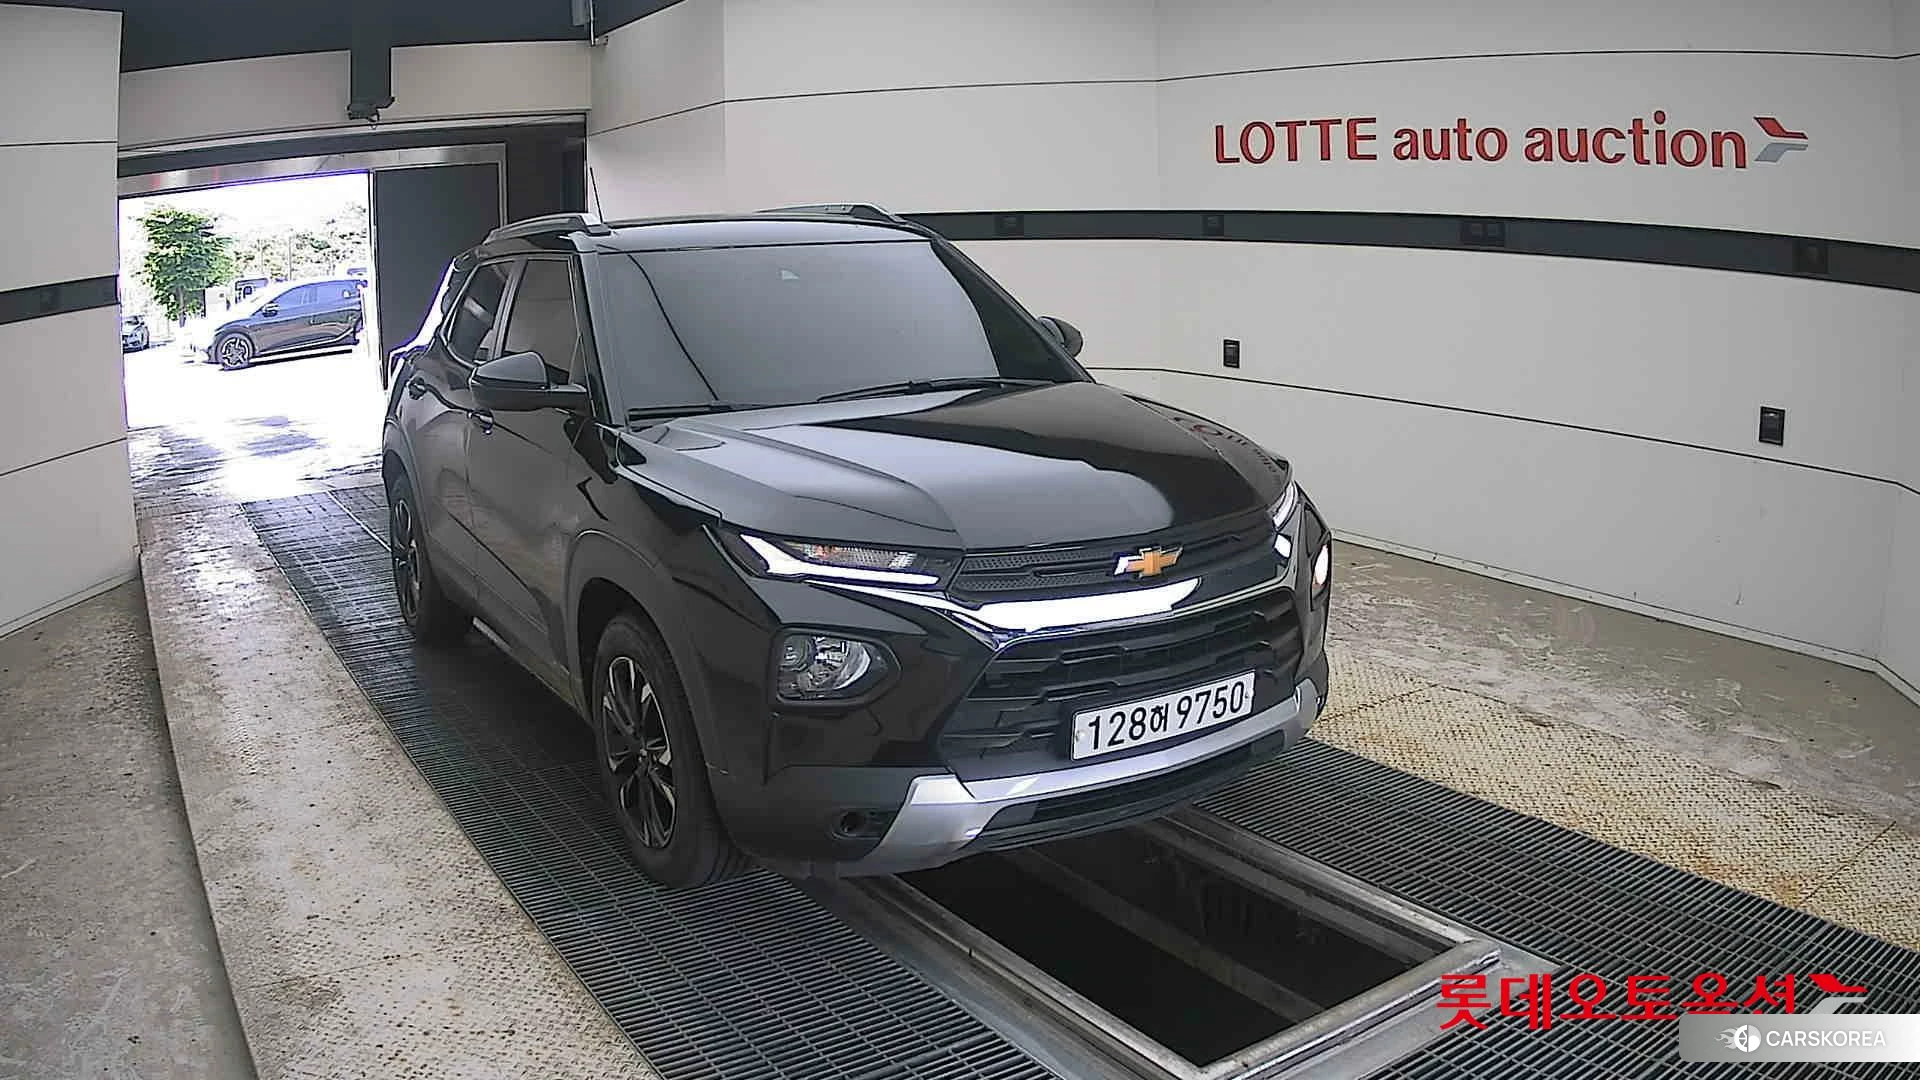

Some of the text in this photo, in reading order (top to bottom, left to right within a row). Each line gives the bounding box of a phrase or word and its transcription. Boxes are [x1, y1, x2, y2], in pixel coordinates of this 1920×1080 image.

[1214, 110, 1748, 169] LOTTE auto auction
[1087, 680, 1246, 750] 128허 9750
